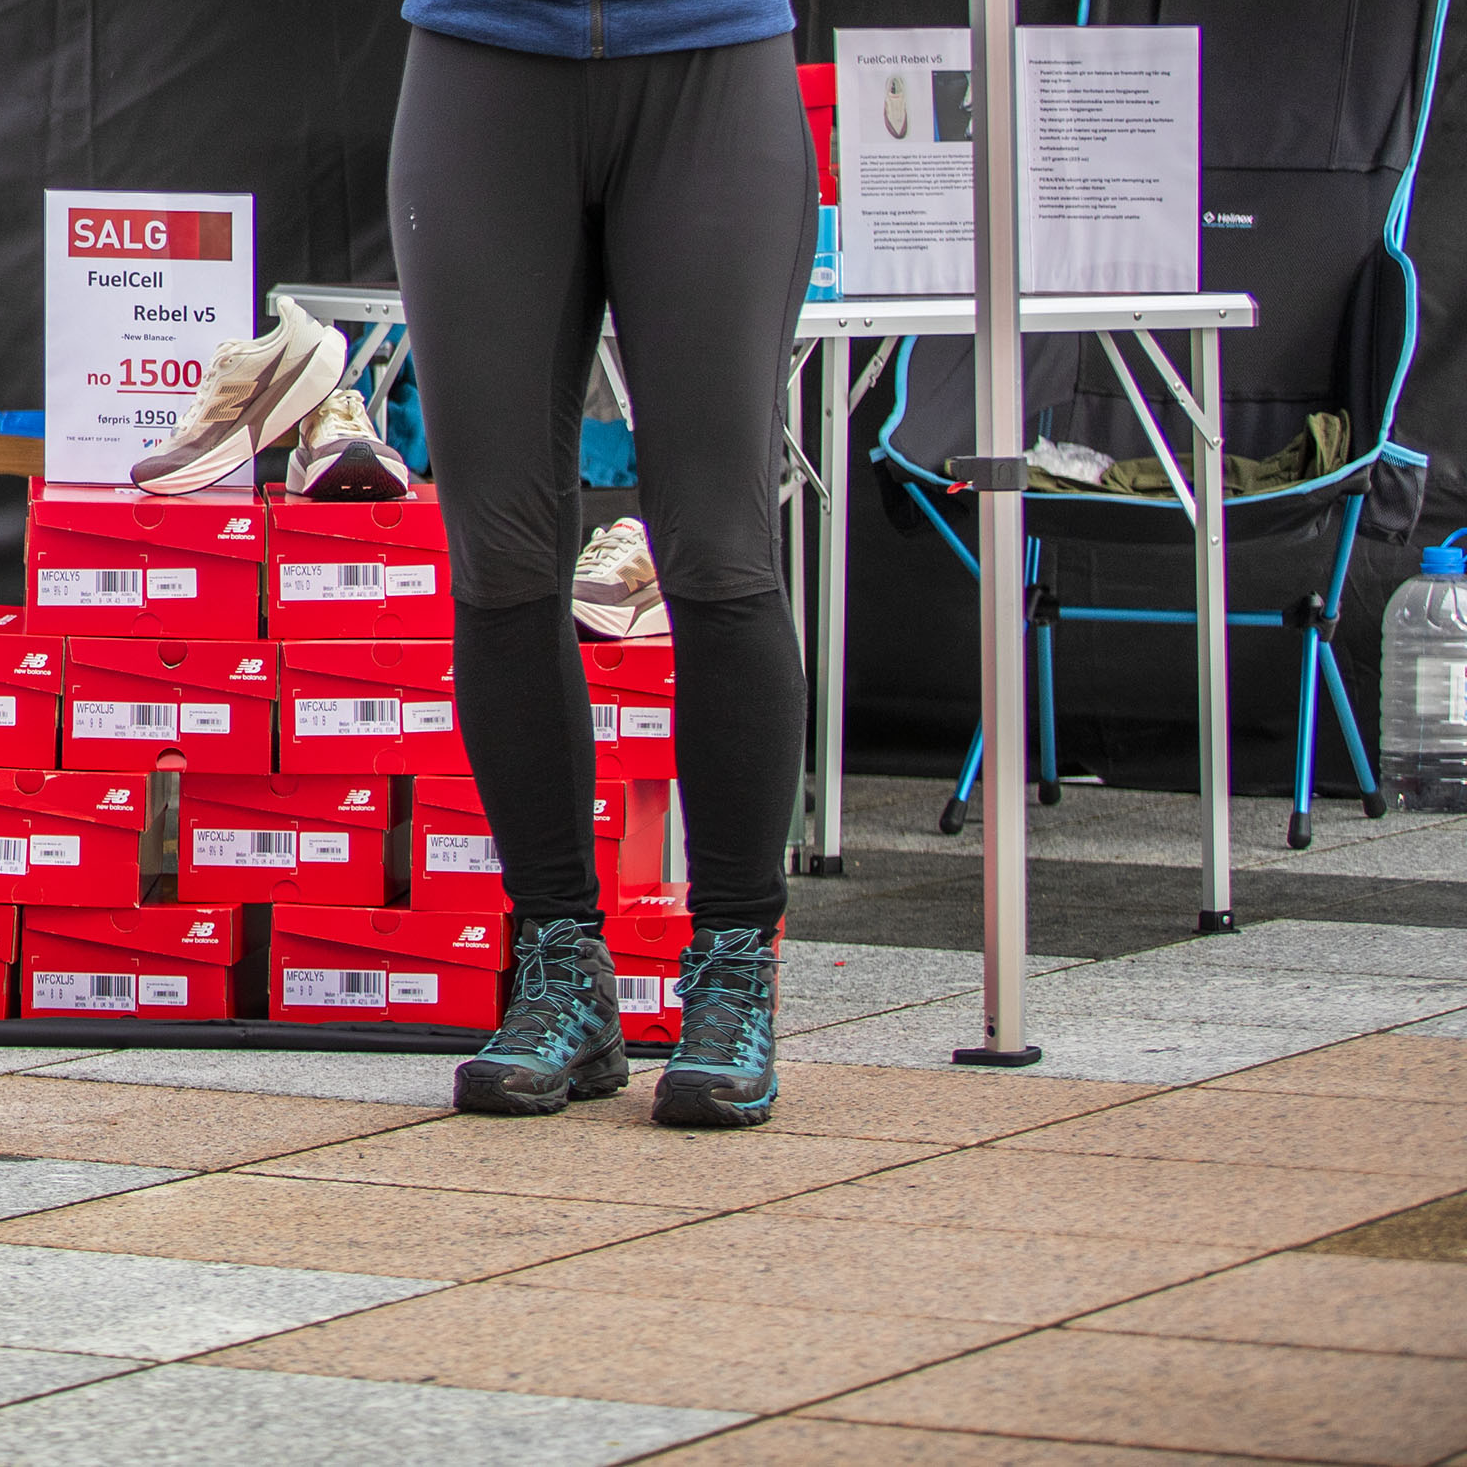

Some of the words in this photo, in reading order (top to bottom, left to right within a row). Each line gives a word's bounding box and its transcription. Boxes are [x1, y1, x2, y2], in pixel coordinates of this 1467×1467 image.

[857, 55, 898, 64] FuelCell
[901, 55, 928, 63] Rebel
[931, 55, 942, 63] v5
[74, 218, 167, 250] SALG
[88, 271, 163, 288] FuelCell
[134, 305, 187, 322] Rebel
[194, 307, 216, 322] v5
[87, 373, 111, 385] no
[119, 359, 202, 388] 1500
[98, 414, 130, 426] førpris
[134, 410, 177, 425] 1950
[230, 533, 255, 541] balance
[41, 571, 80, 582] MFCXLY5
[283, 566, 322, 576] MFCXLY5
[26, 668, 52, 676] balance
[76, 703, 114, 714] WFCXLJ5
[299, 701, 337, 712] WFCXLJ5
[594, 800, 607, 814] B
[197, 831, 235, 842] WFCXLJ5
[431, 837, 468, 848] WFCXLJ5
[466, 941, 490, 949] balance
[37, 974, 74, 985] WFCXLJ5
[286, 971, 324, 982] MFCXLY5
